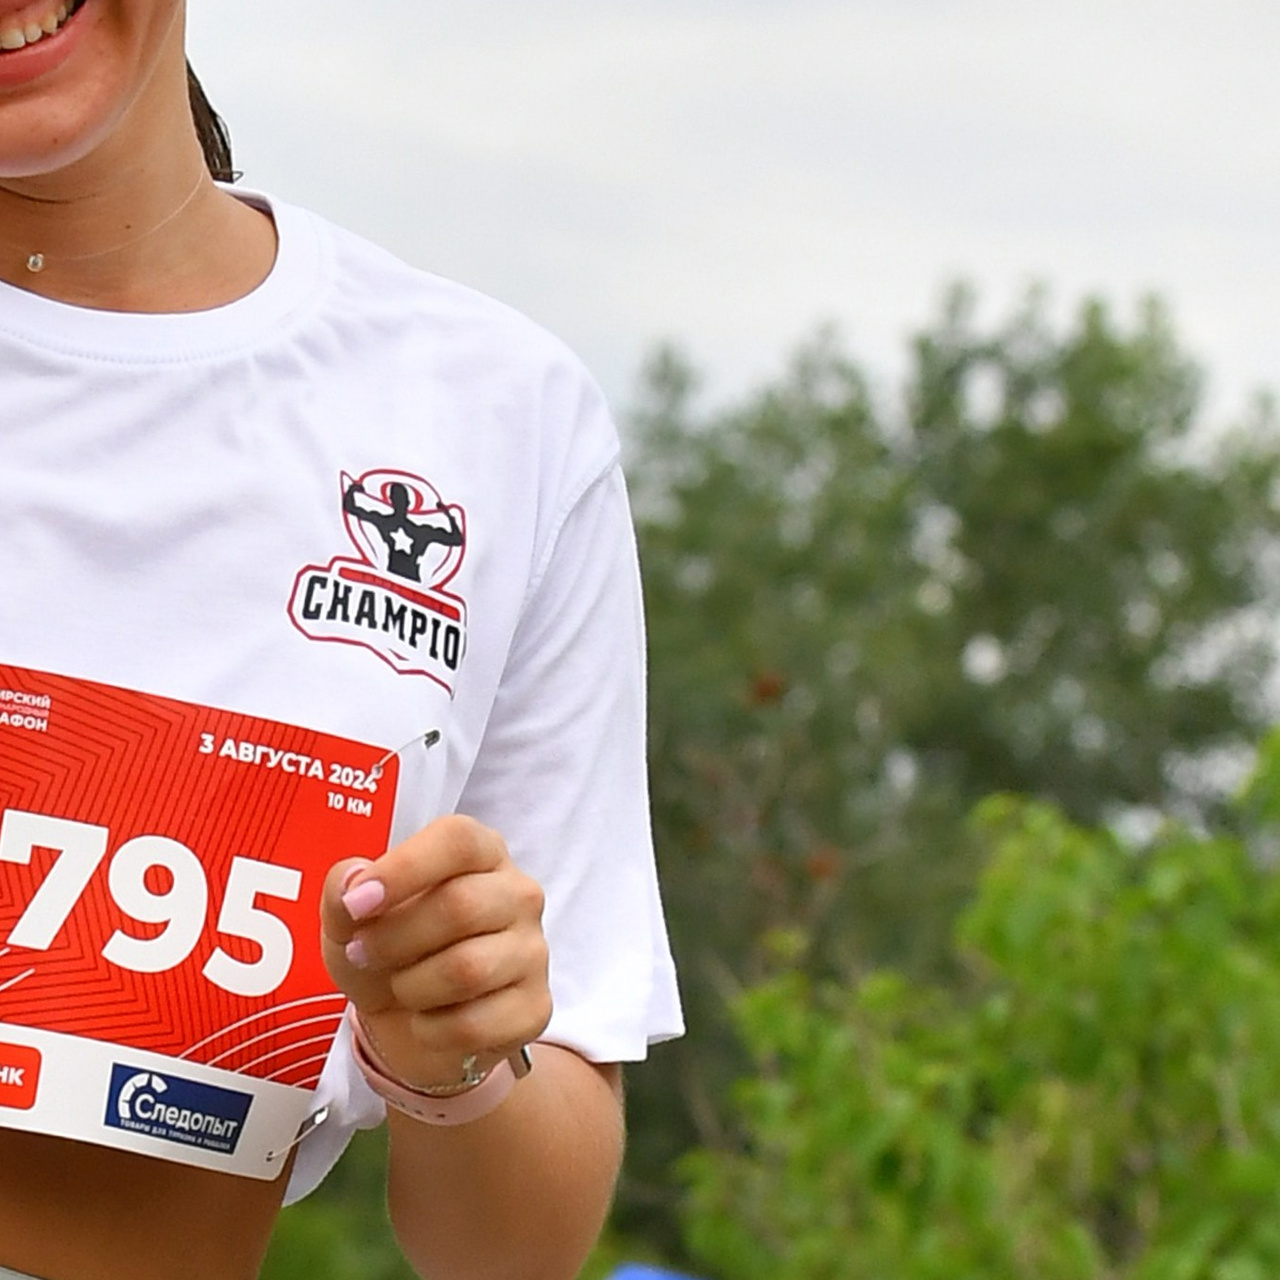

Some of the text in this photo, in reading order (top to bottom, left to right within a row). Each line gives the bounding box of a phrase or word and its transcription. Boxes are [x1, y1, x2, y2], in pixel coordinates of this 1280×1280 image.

[199, 733, 378, 793] 3 АВГУСТА 2024
[327, 792, 373, 818] 10 КМ
